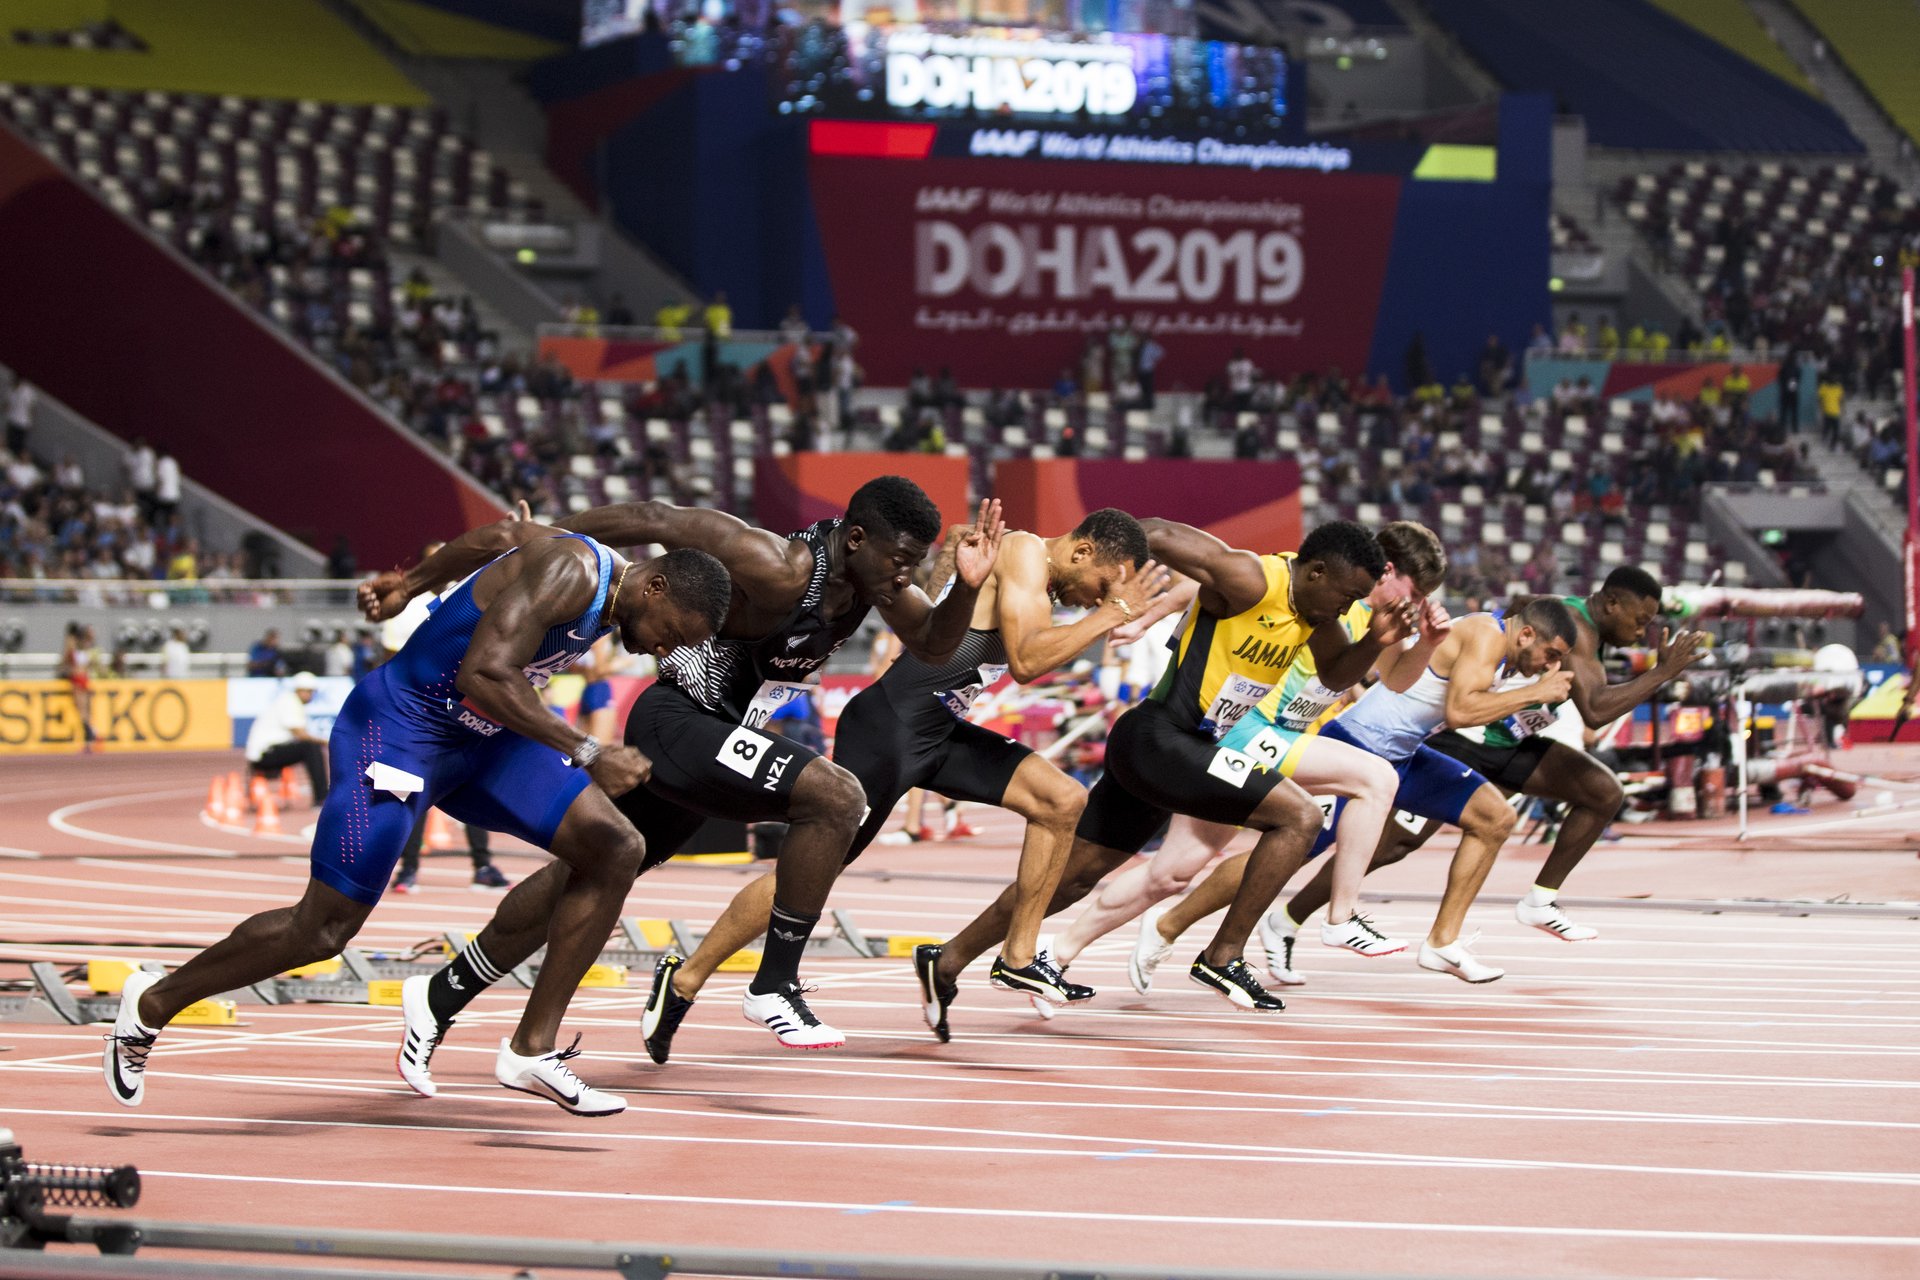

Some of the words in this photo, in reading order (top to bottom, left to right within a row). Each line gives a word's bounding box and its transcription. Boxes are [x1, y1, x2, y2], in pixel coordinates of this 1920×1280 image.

[1041, 131, 1104, 160] World
[1104, 134, 1194, 163] Athletics
[1196, 137, 1351, 172] Championships
[1148, 194, 1302, 225] Championships
[733, 739, 758, 761] 8
[1259, 740, 1278, 758] 5
[763, 754, 794, 792] NZL
